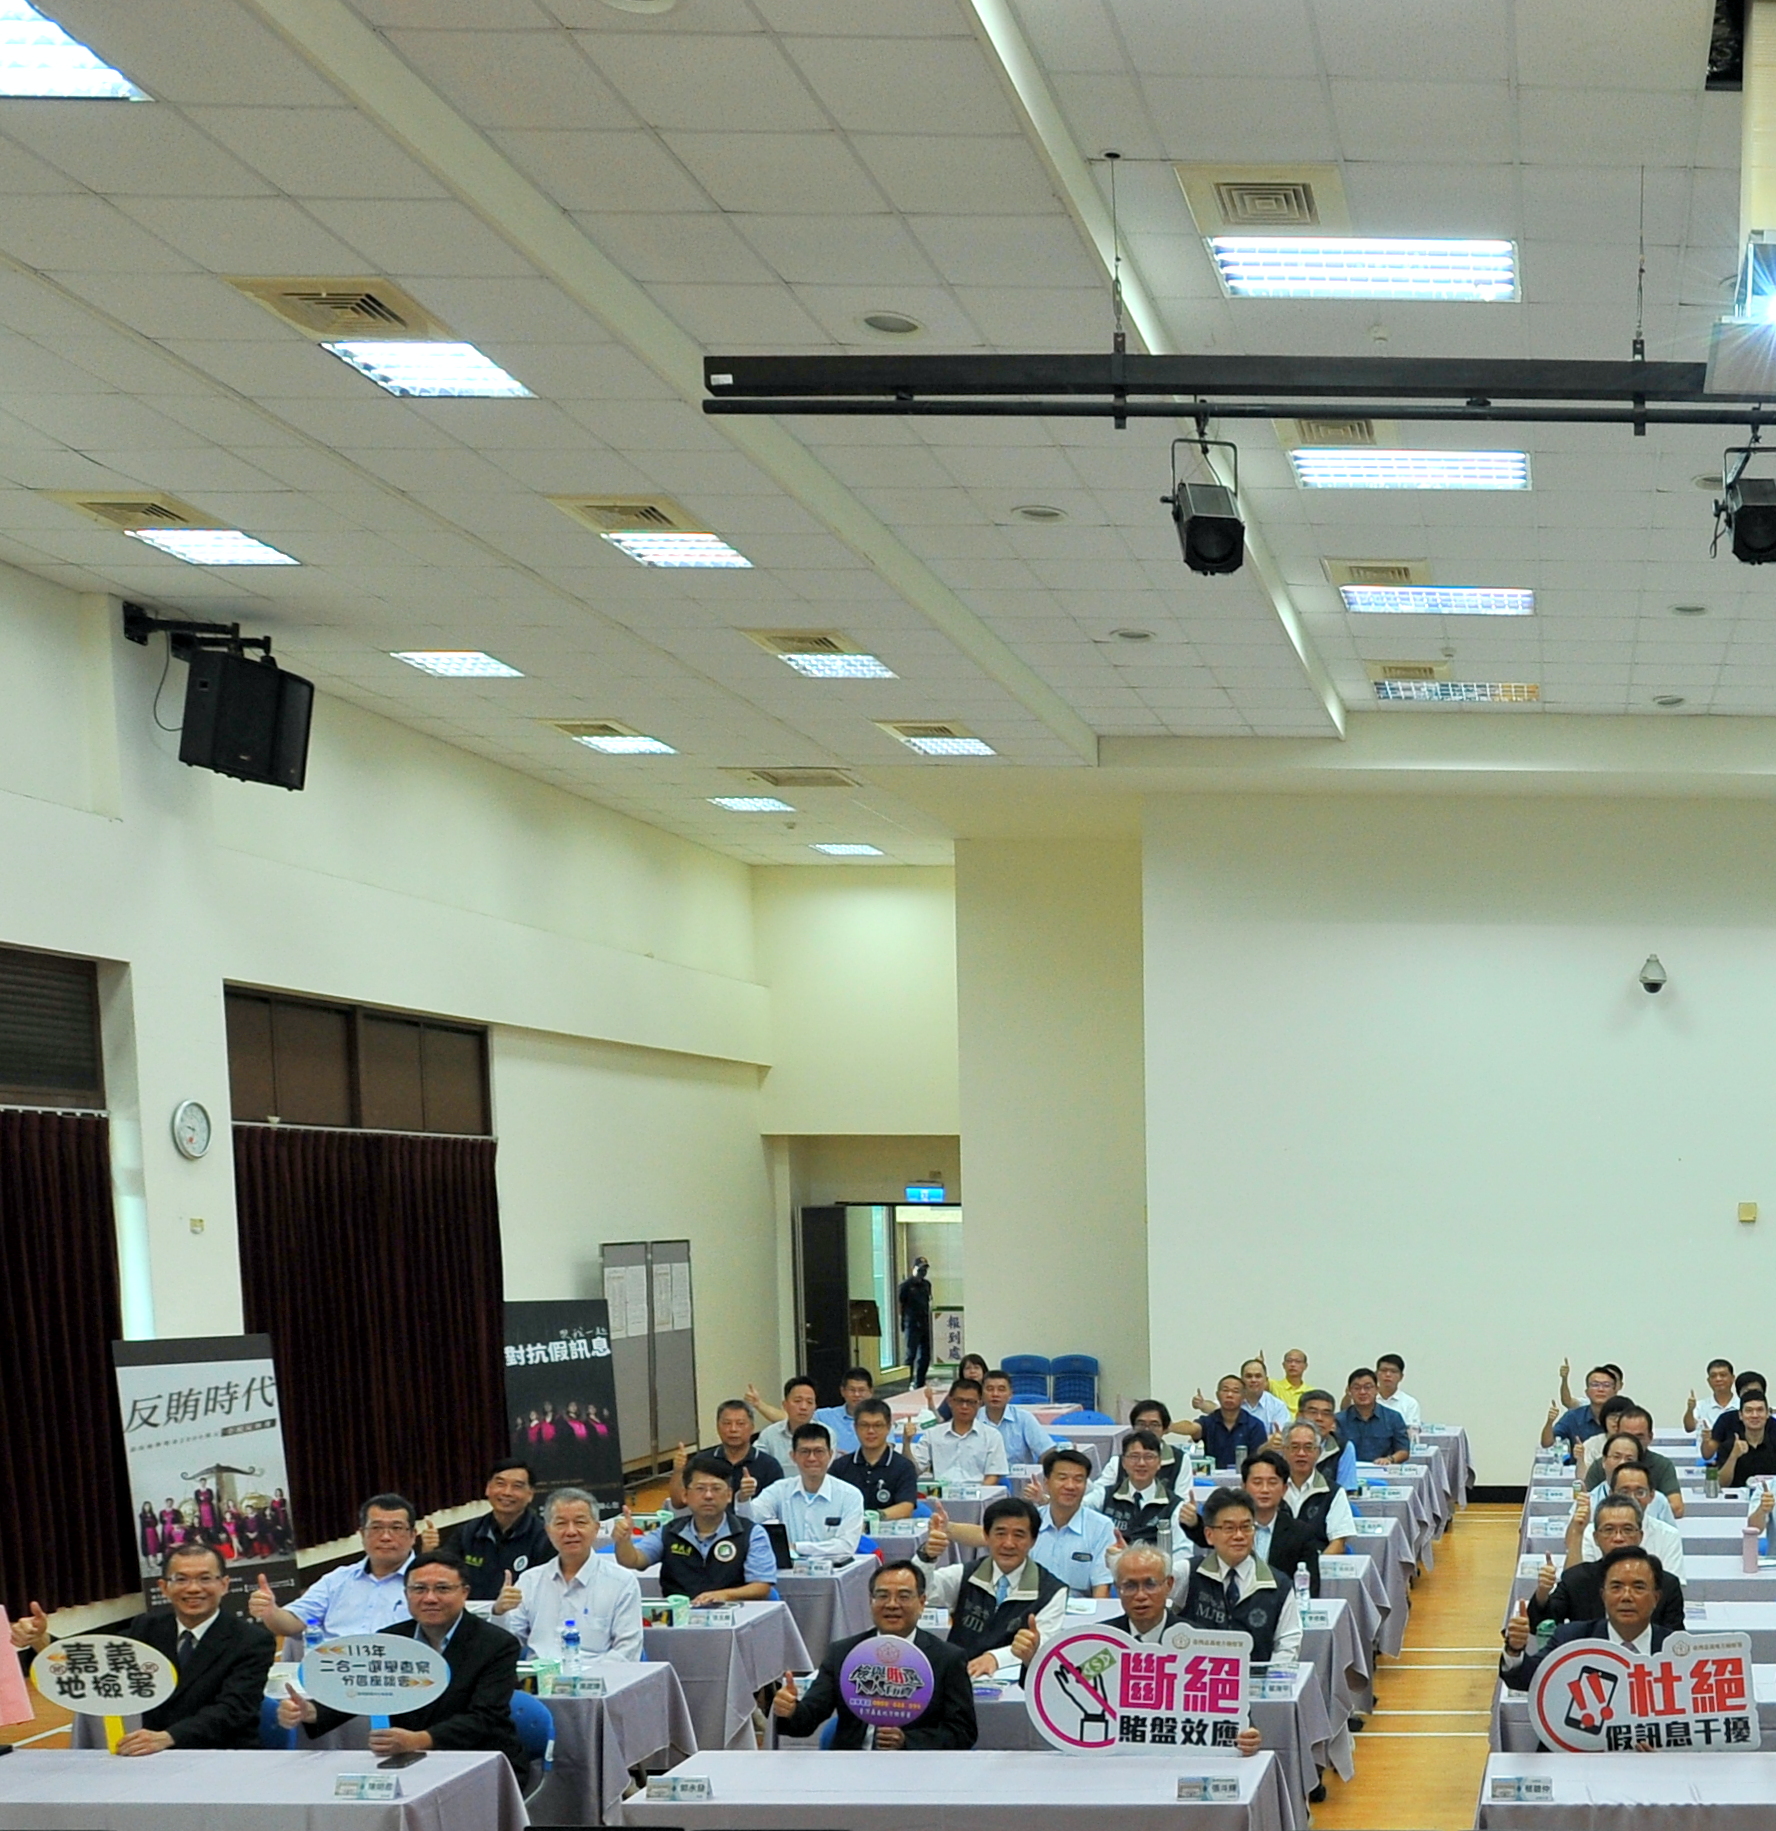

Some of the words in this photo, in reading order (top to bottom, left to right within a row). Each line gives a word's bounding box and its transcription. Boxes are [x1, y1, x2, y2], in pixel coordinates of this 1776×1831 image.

[504, 1336, 611, 1367] 對抗假訊息
[947, 1315, 961, 1360] 報到處
[125, 1375, 276, 1433] 反賄時代
[1196, 1602, 1226, 1624] MJB
[62, 1640, 140, 1674] 嘉義
[348, 1644, 386, 1657] 113年
[56, 1672, 156, 1699] 地檢署
[1119, 1652, 1240, 1714] 斷絕
[1627, 1657, 1748, 1717] 杜絕
[1119, 1715, 1240, 1748] 賭盤效應
[1606, 1716, 1752, 1751] 假訊息干擾
